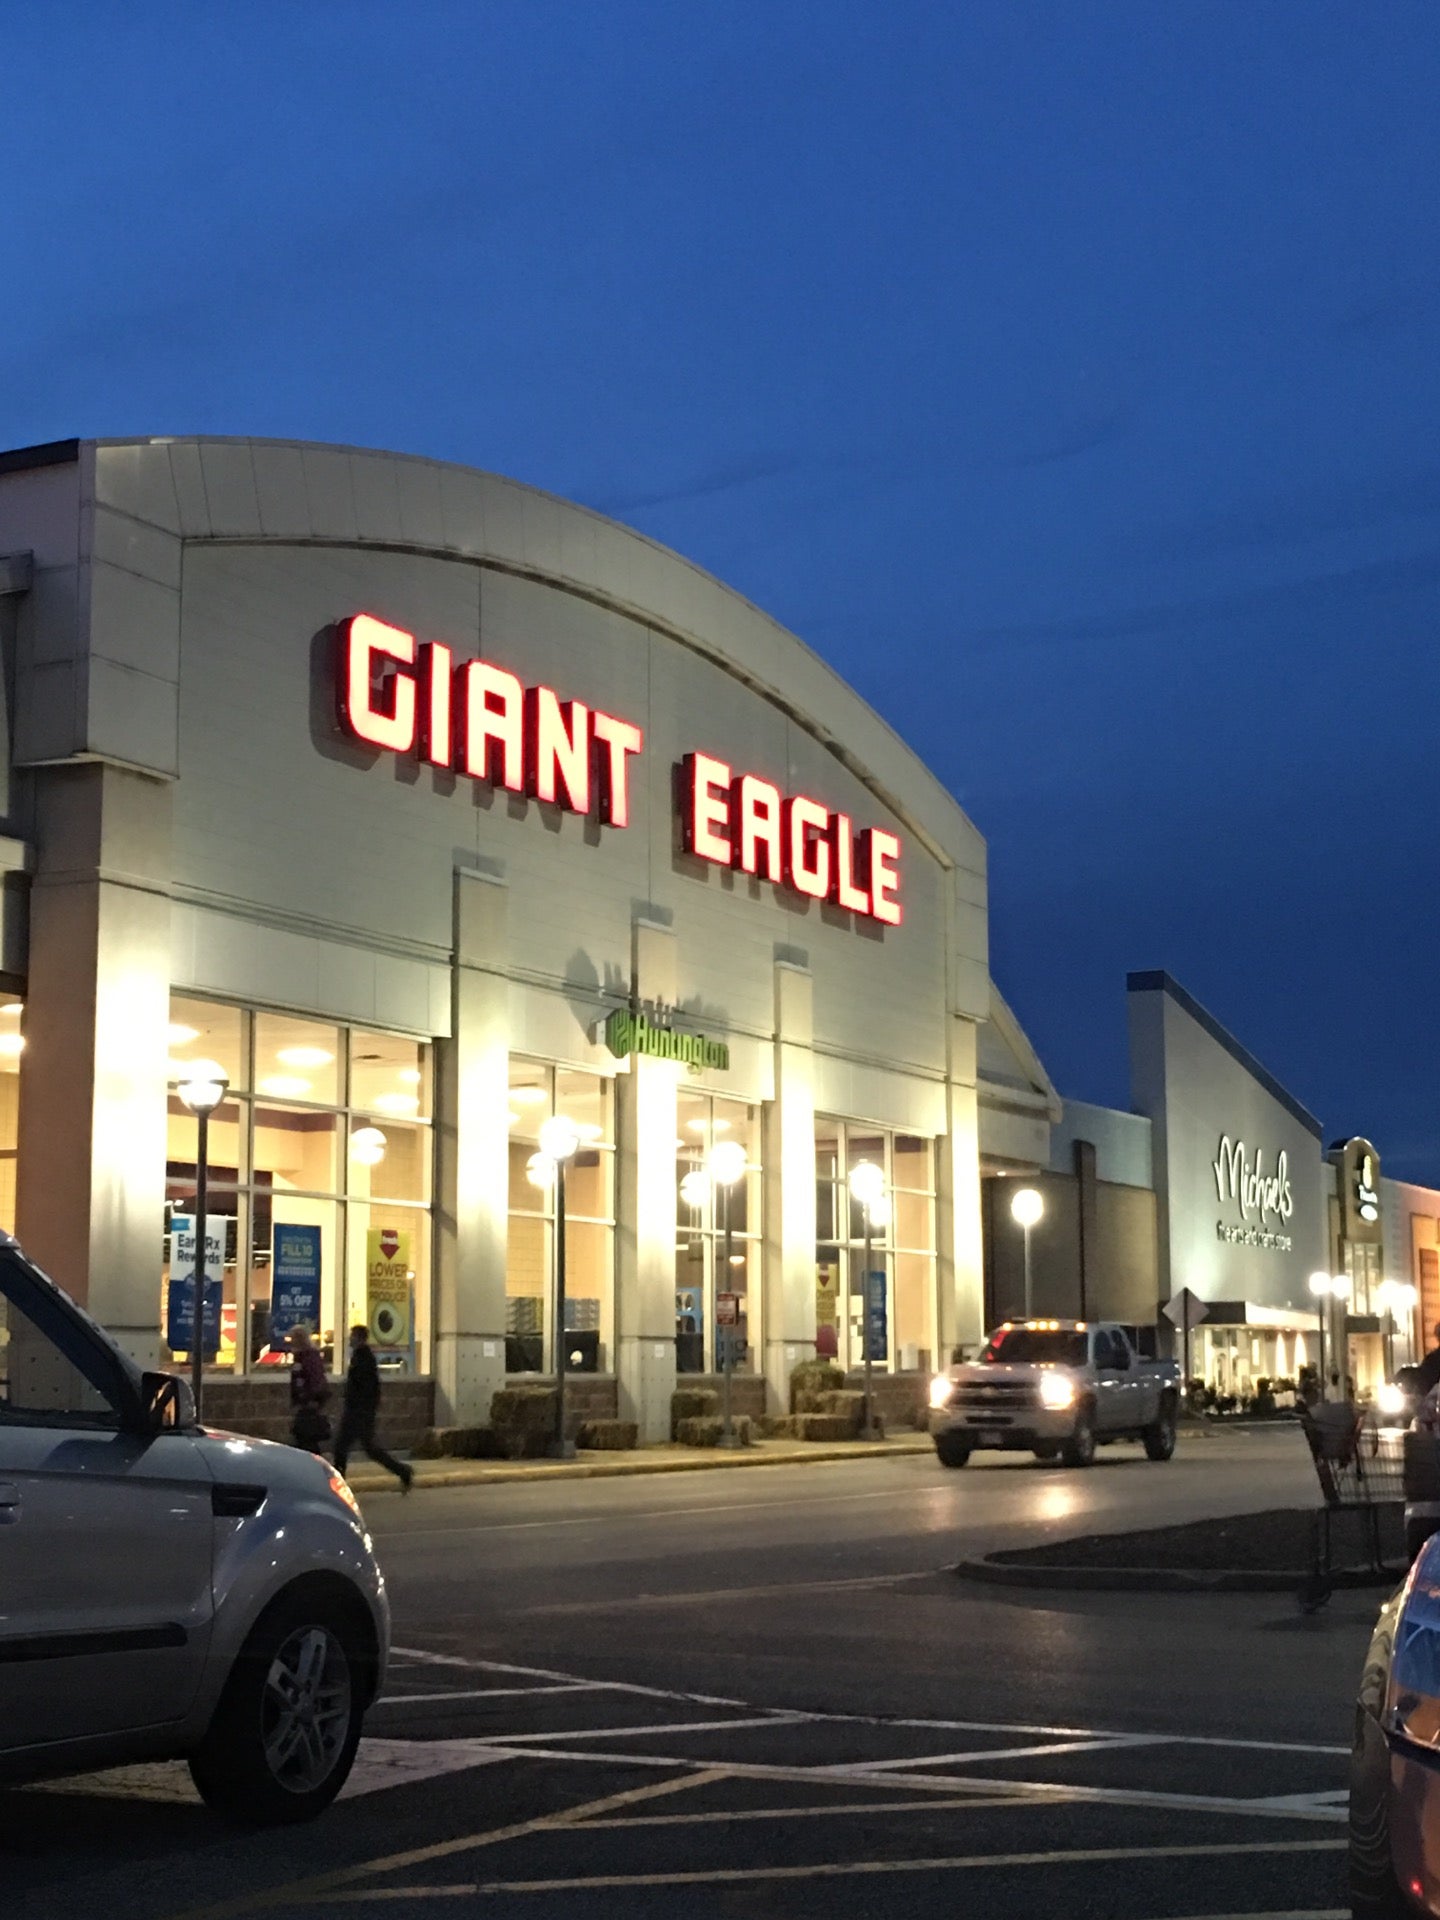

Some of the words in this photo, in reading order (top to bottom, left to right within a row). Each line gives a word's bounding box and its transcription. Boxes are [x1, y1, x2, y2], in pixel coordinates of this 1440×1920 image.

[340, 612, 644, 828] GIANT
[684, 751, 903, 926] EAGLE
[634, 1013, 729, 1075] Huntington
[1213, 1135, 1293, 1226] Michaels
[177, 1249, 220, 1264] Rewrds
[178, 1233, 199, 1248] Ear
[205, 1236, 221, 1250] Rx
[369, 1262, 408, 1277] LOWER
